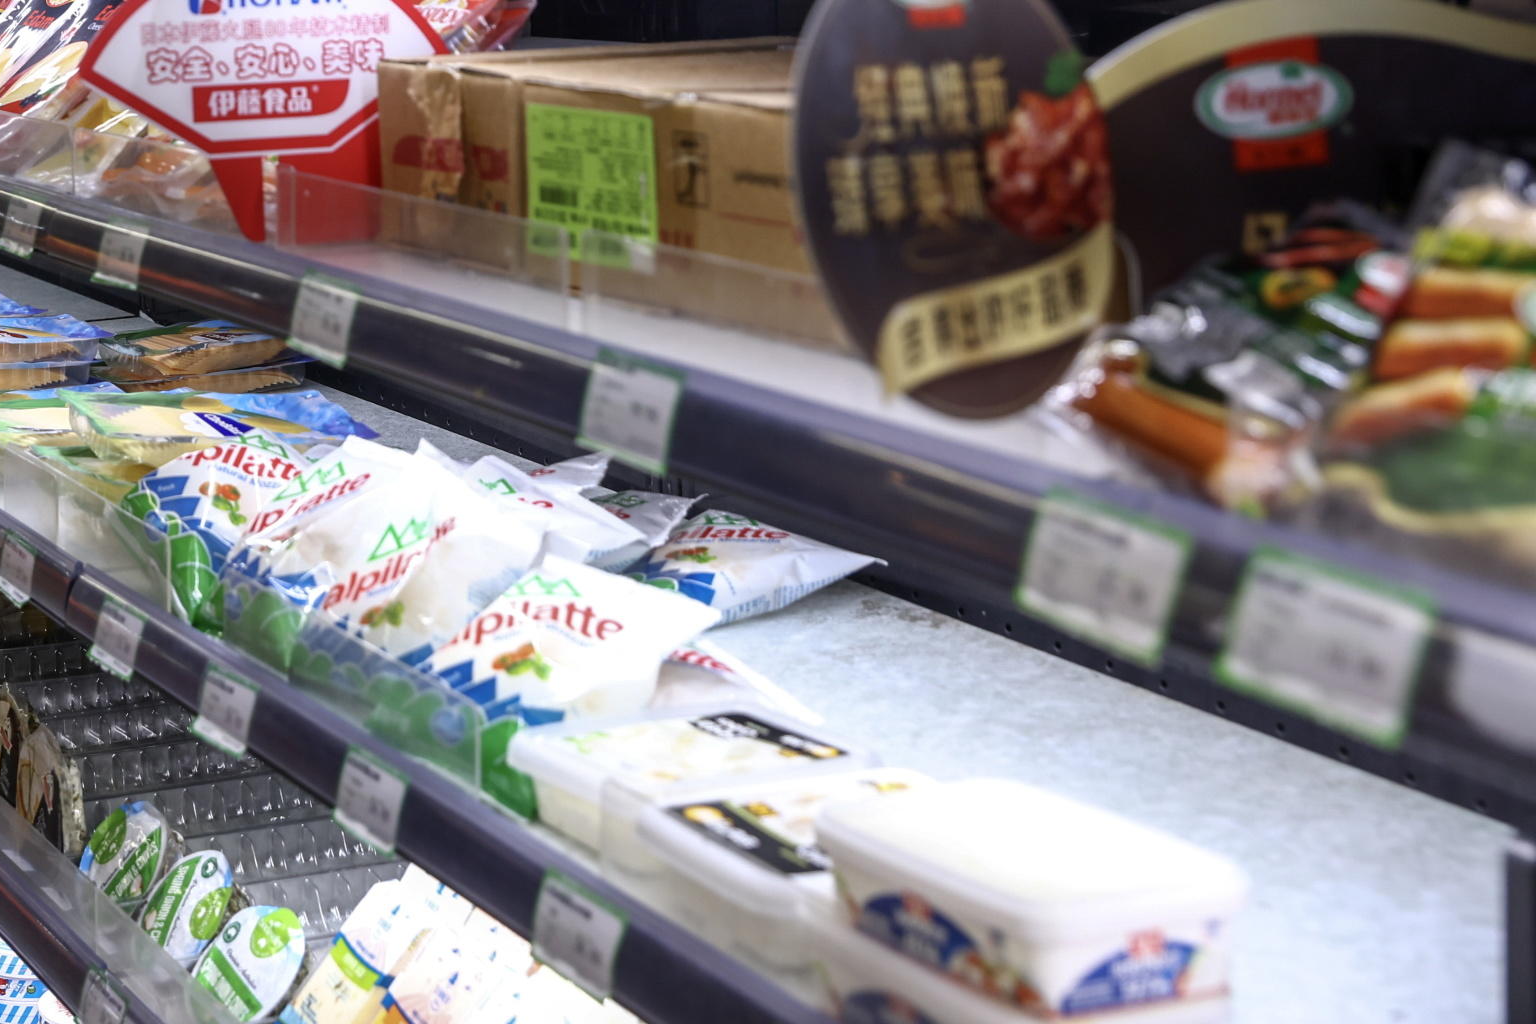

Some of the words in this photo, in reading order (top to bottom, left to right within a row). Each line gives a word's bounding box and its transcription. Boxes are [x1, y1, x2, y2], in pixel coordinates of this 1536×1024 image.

[146, 37, 386, 84] 安全、安心、美味
[208, 86, 313, 118] 伊藤食品
